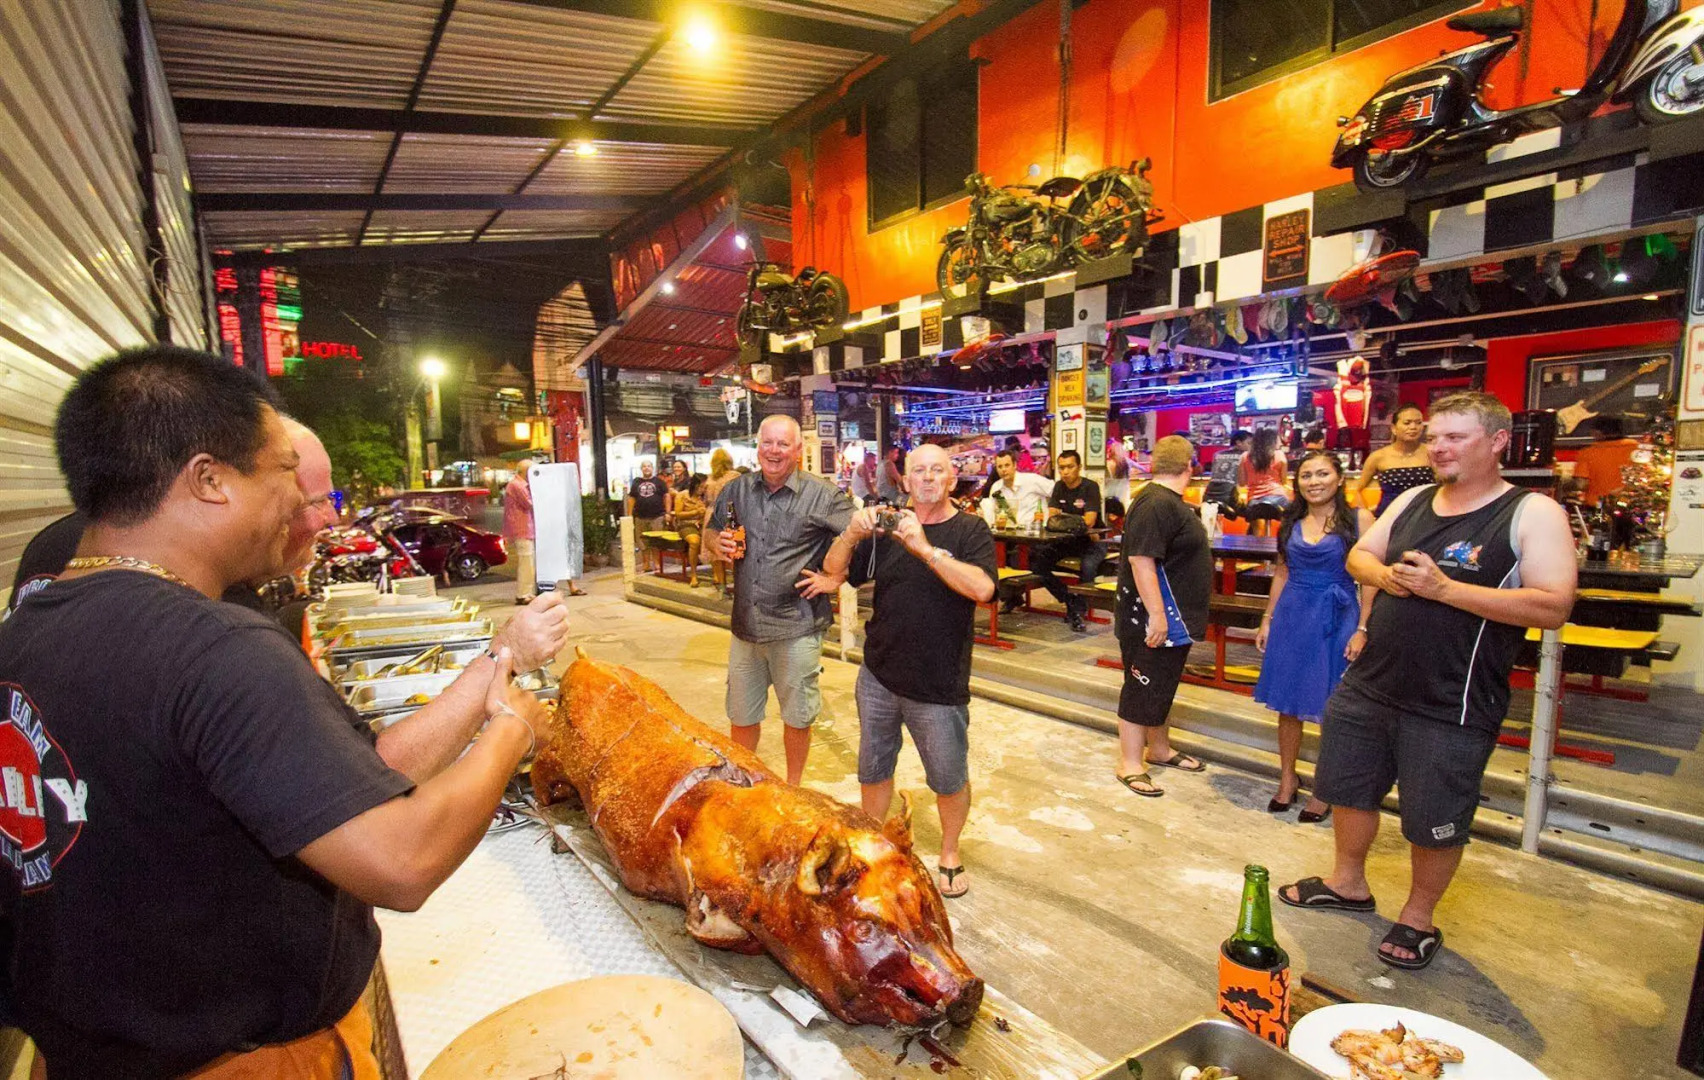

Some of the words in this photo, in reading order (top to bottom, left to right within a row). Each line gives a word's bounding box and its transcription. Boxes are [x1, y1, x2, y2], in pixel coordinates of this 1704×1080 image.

[1269, 225, 1305, 239] REPAIR
[1273, 236, 1300, 248] SHOP
[302, 341, 363, 361] HOTEL
